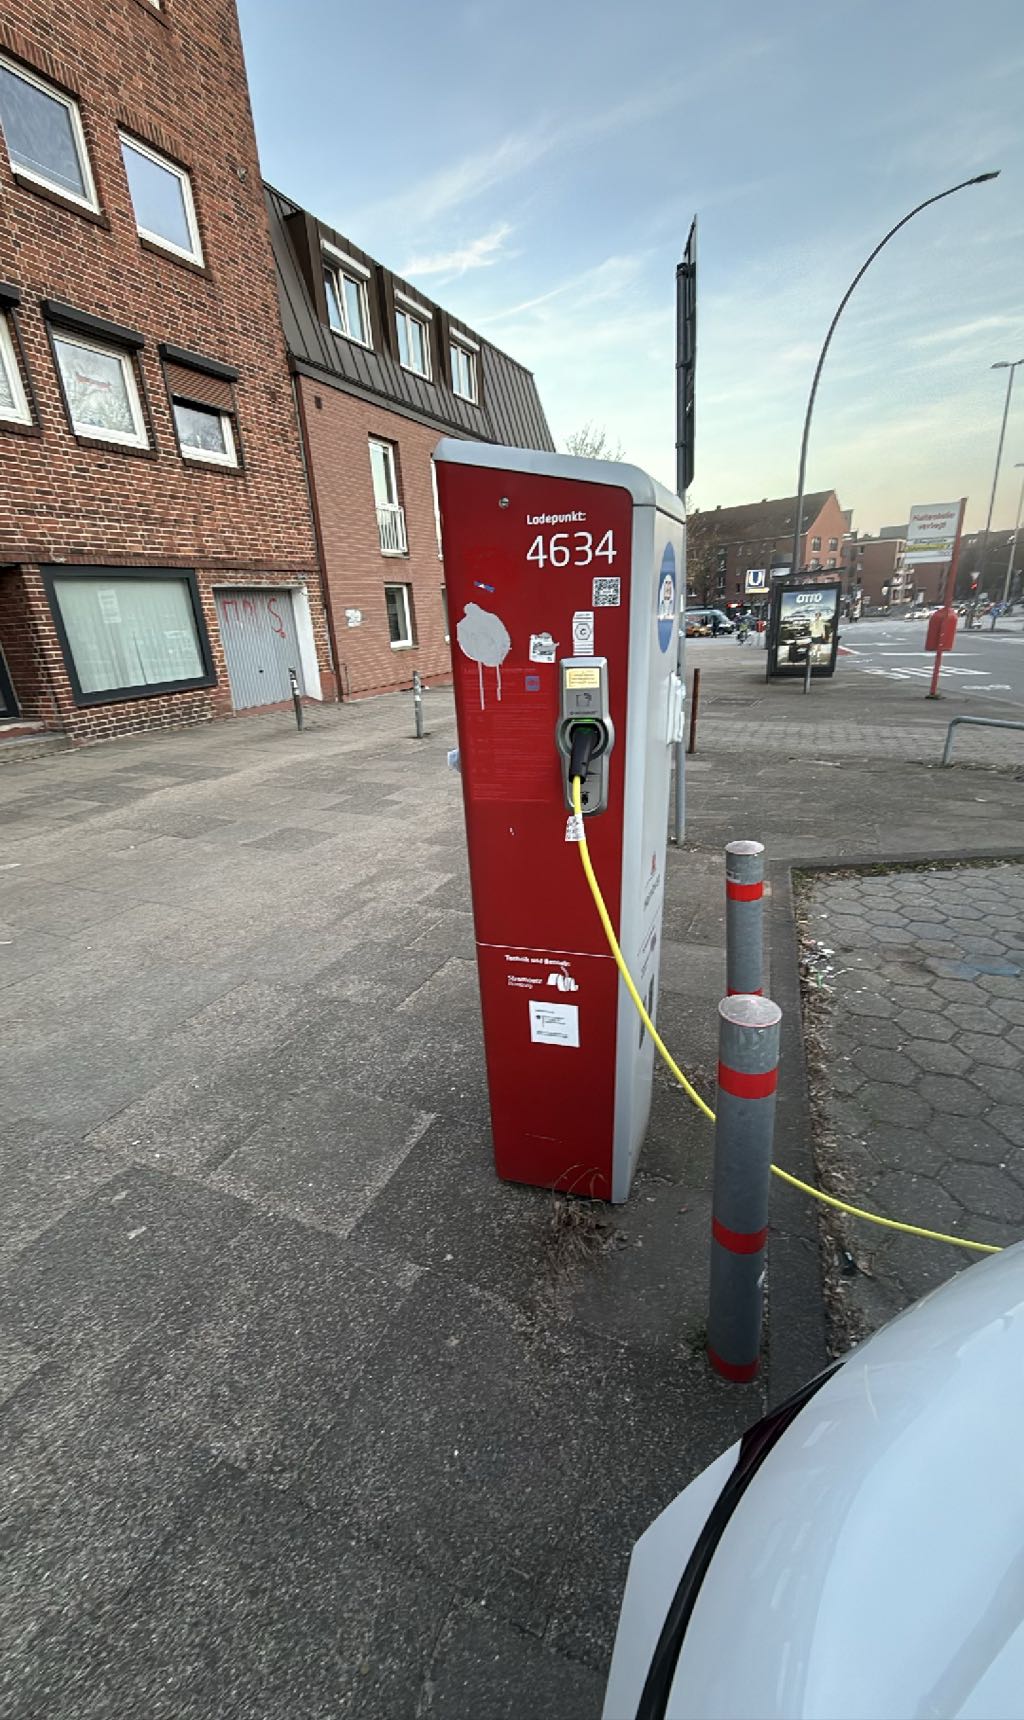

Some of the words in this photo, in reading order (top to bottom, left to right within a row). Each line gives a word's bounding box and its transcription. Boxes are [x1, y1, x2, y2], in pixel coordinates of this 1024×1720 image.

[526, 511, 587, 526] Ladepunkt:
[526, 529, 617, 569] 4634
[748, 571, 762, 586] U
[795, 592, 824, 604] OTTO
